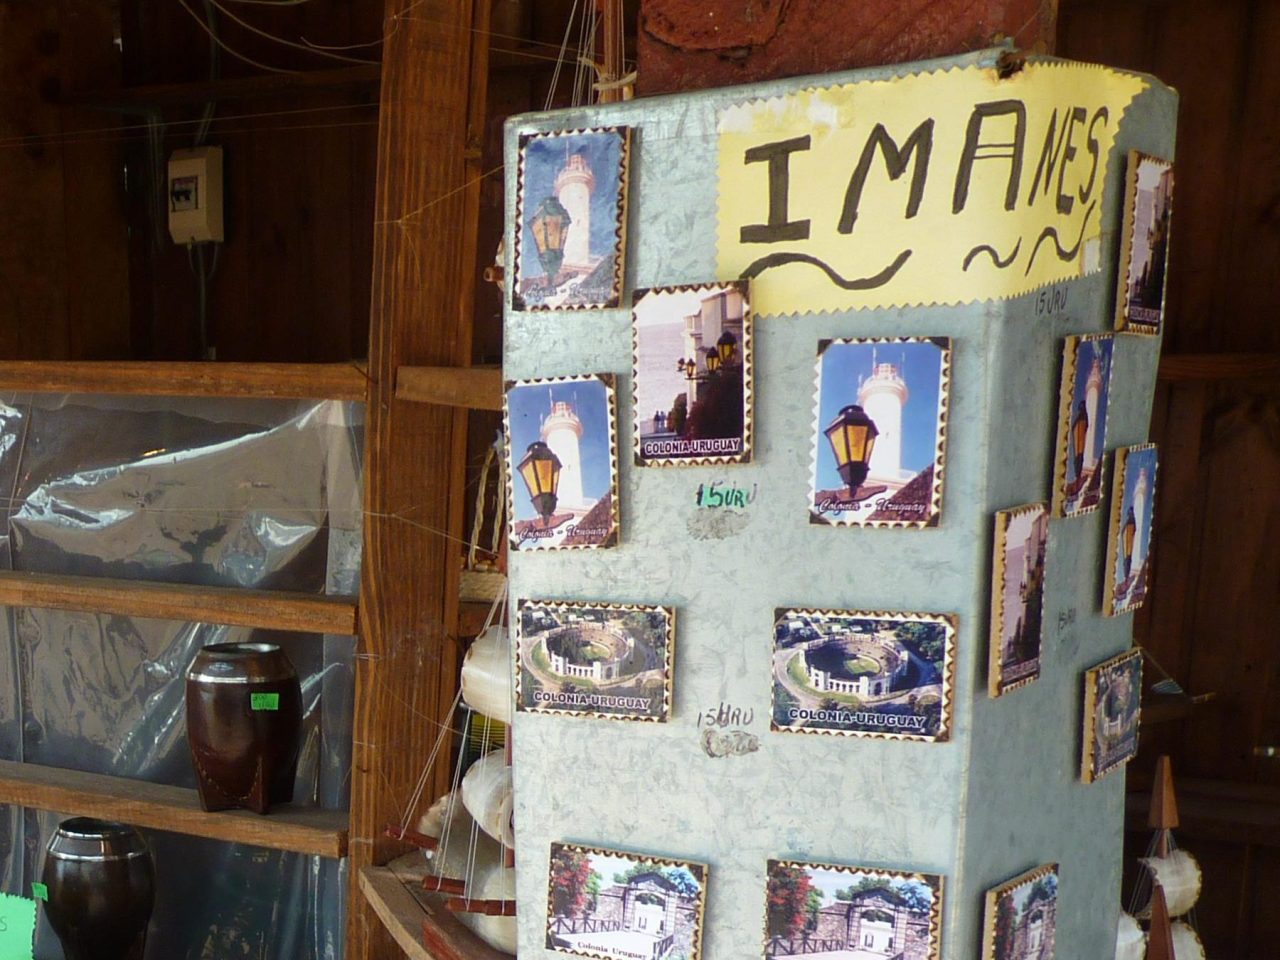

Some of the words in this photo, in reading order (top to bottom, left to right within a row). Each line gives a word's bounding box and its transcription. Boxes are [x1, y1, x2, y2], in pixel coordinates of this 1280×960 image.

[740, 100, 1109, 243] IMANES
[645, 438, 741, 455] COLONIA-URUGUAY
[534, 691, 651, 710] COLONIA-URUGUAY
[788, 708, 926, 729] COLONIA-URUGUAY
